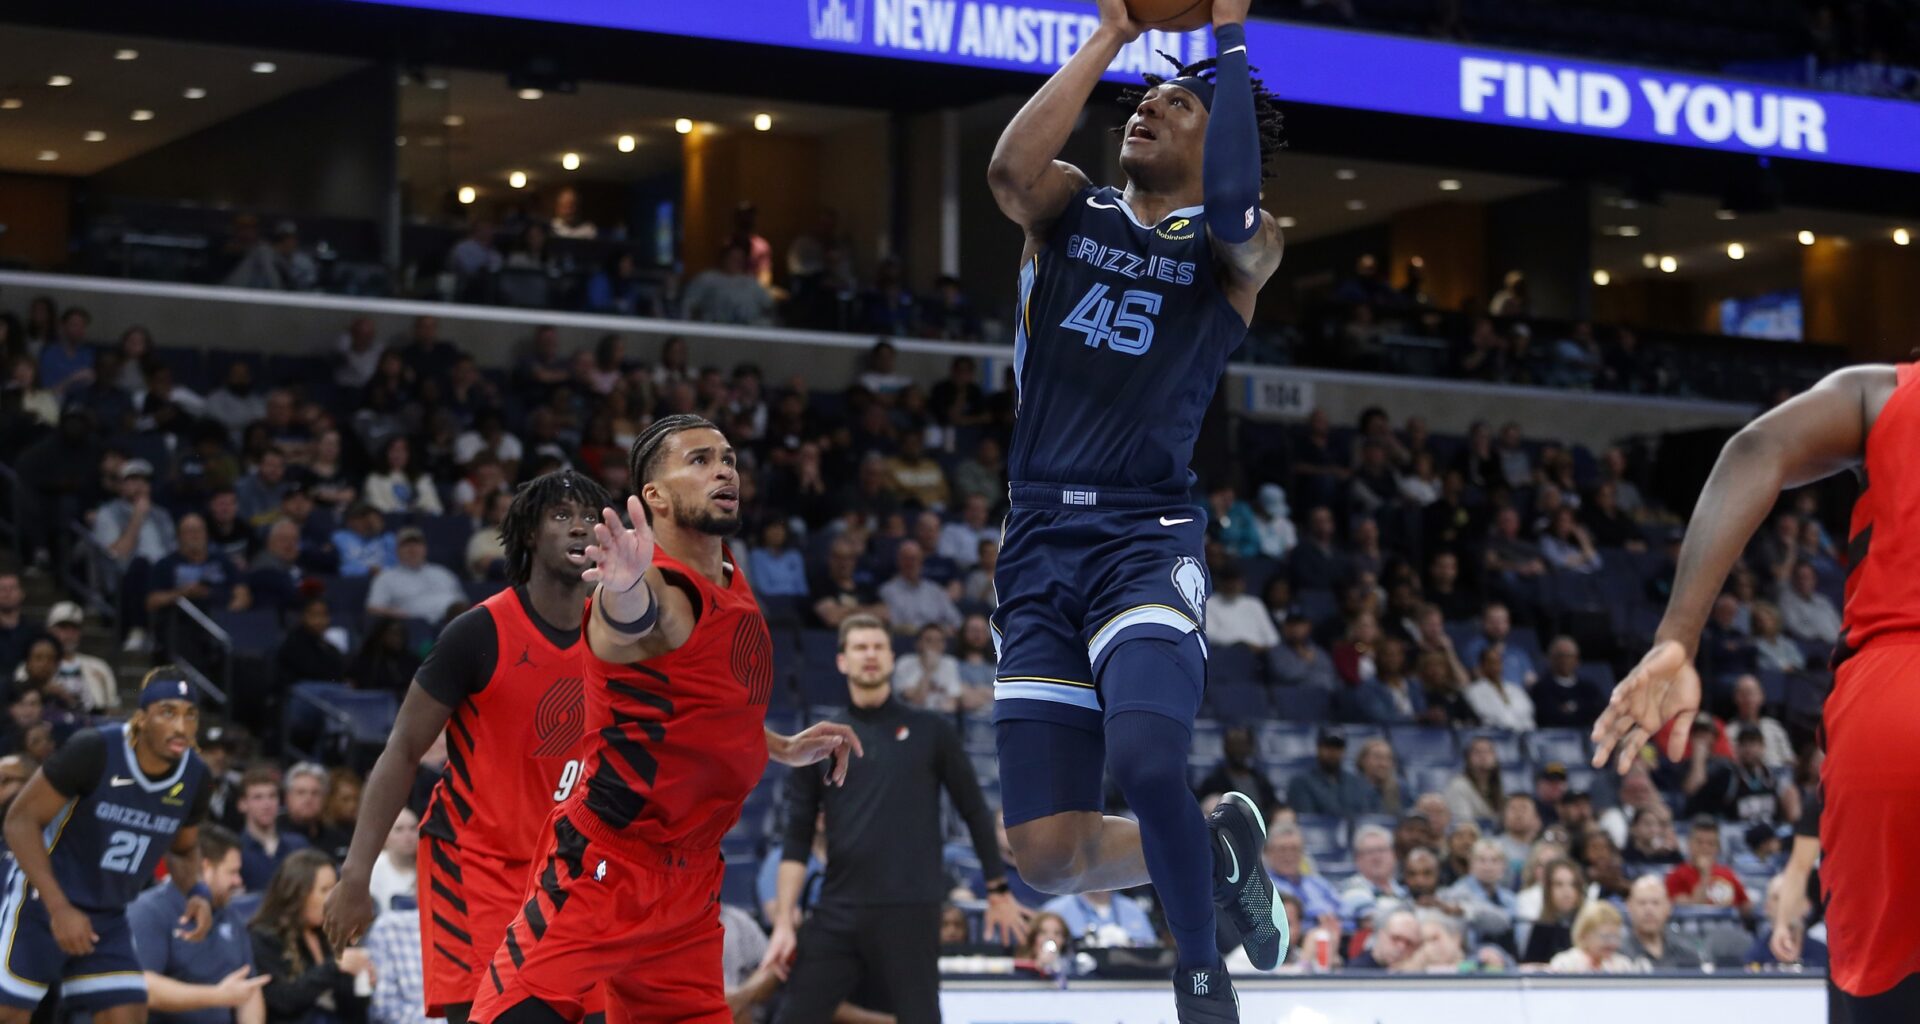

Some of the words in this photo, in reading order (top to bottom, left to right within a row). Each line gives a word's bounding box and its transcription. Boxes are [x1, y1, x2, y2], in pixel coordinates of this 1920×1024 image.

[873, 0, 957, 53] NEW
[1459, 56, 1632, 129] FIND
[1638, 78, 1829, 153] YOUR
[1067, 234, 1196, 286] GRIZZIES
[1059, 282, 1163, 356] 45
[553, 759, 585, 802] 9
[96, 801, 180, 835] GRIZZLIES
[100, 830, 152, 875] 21
